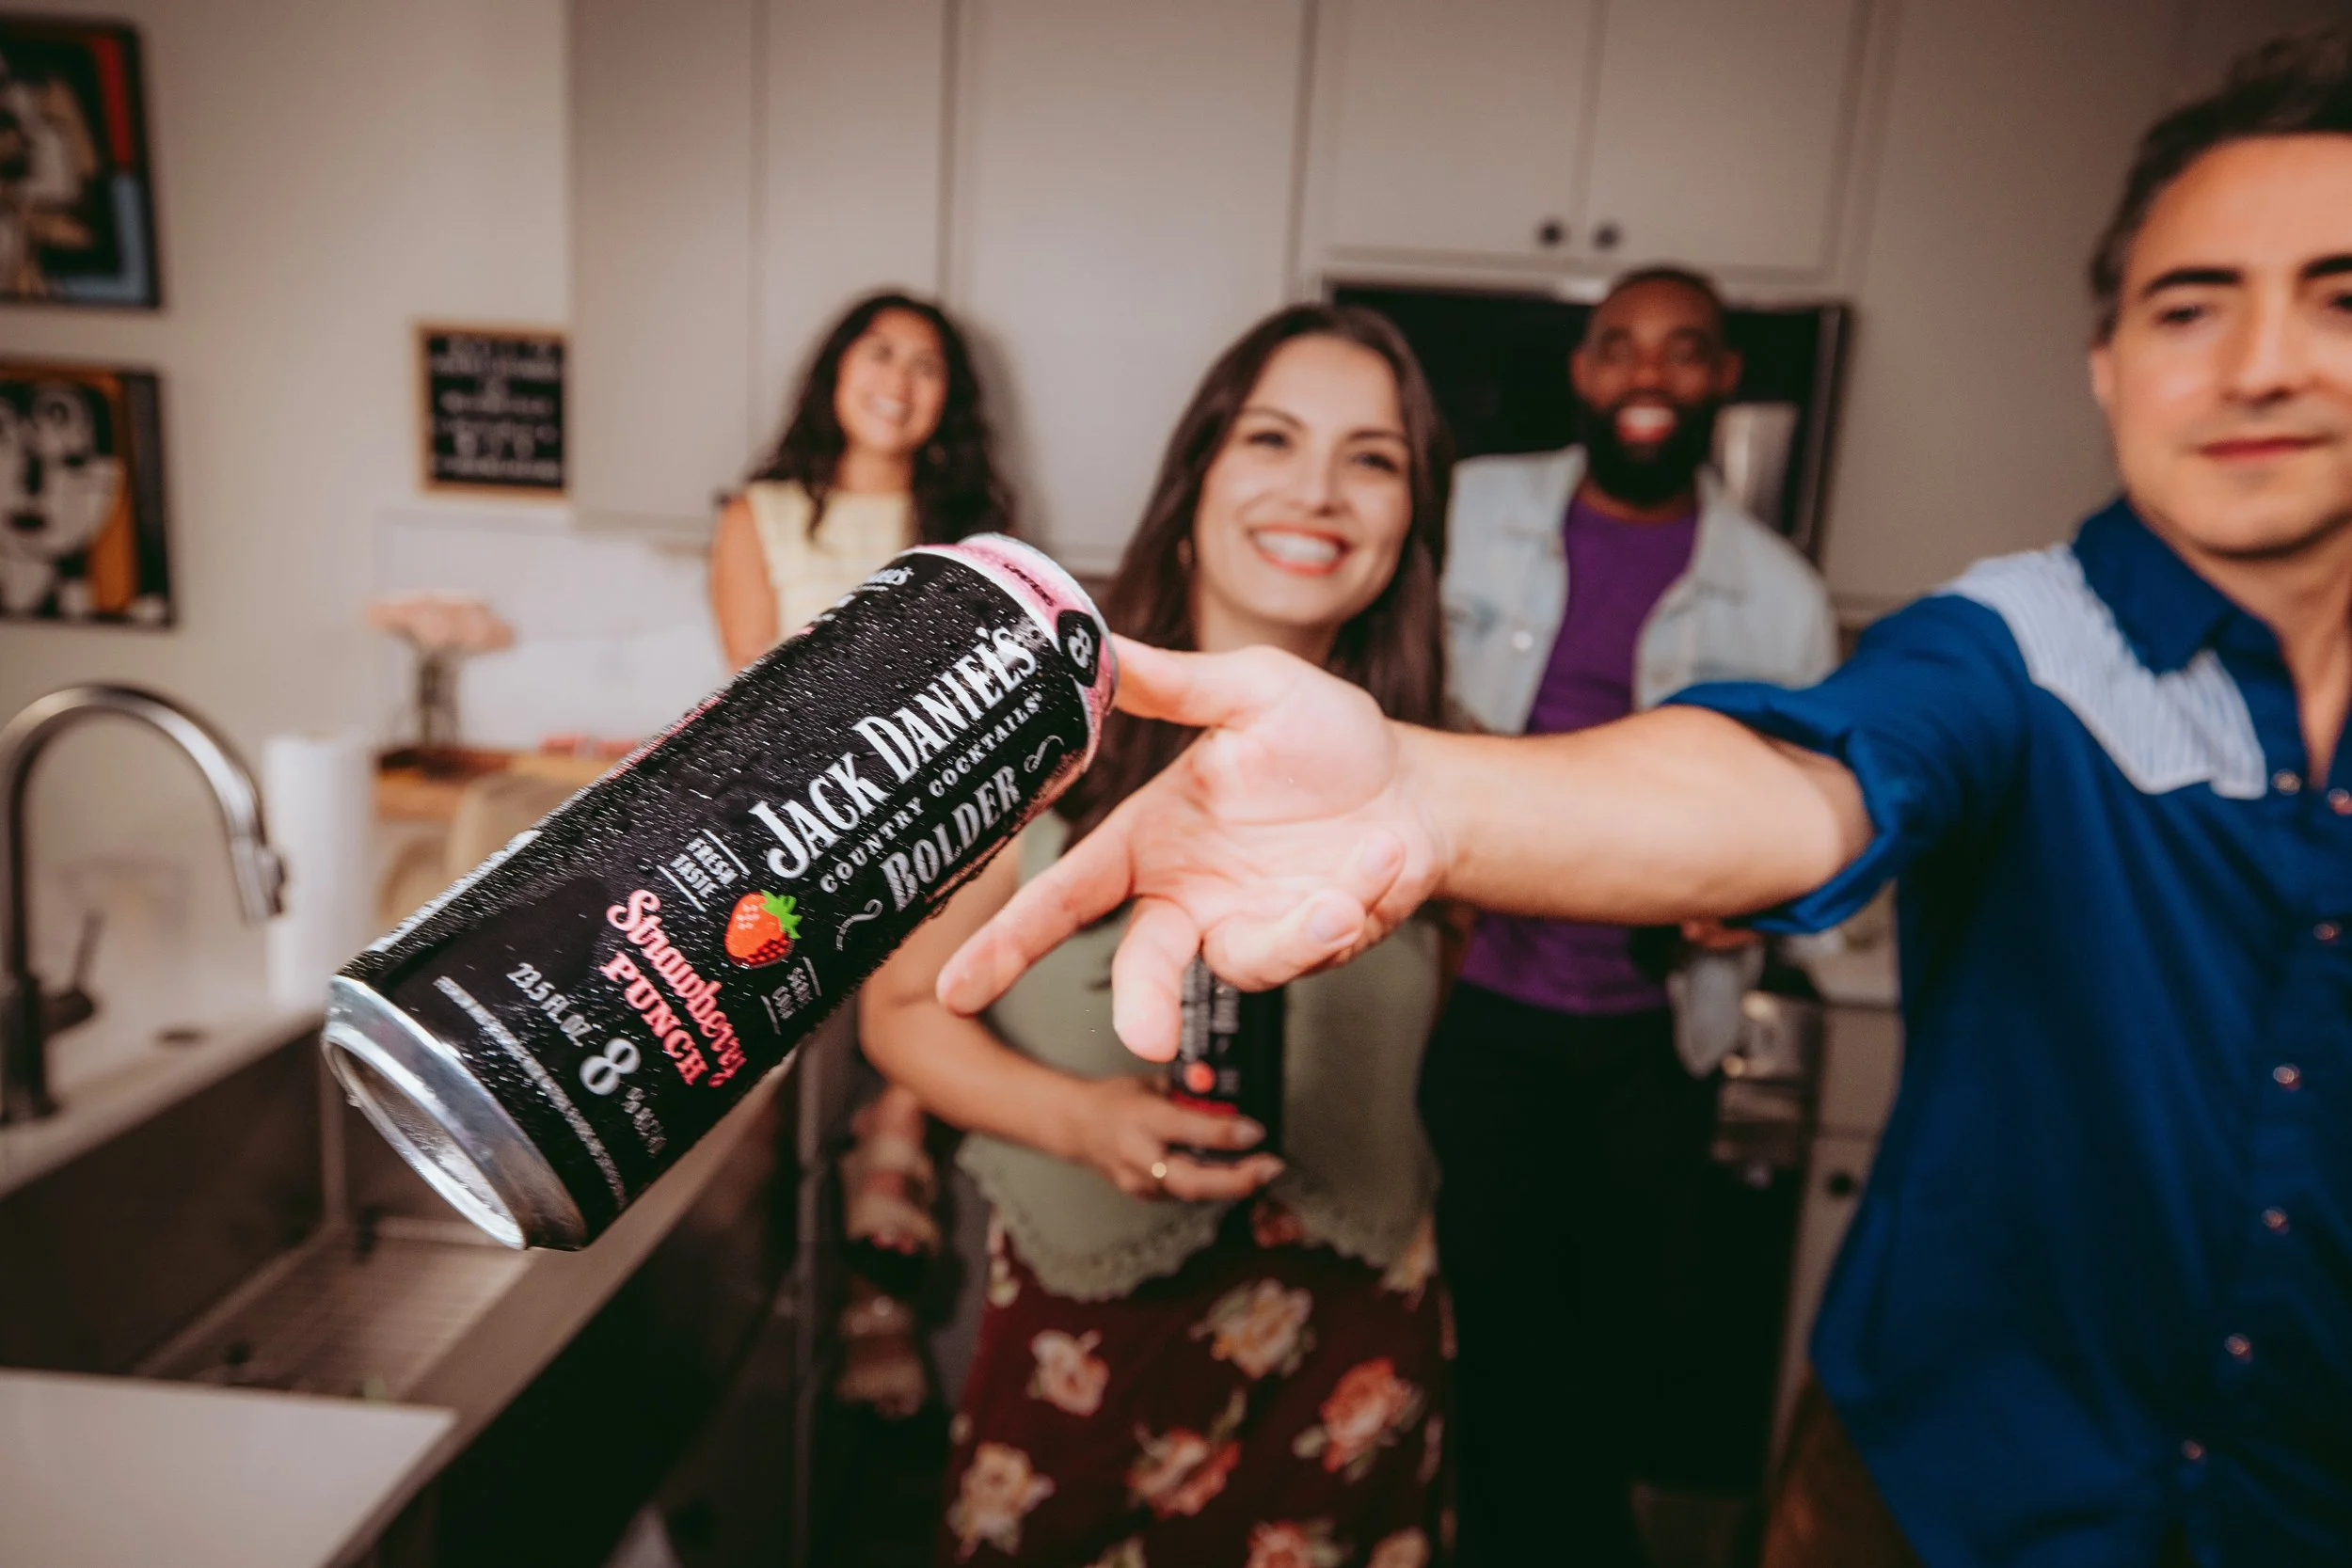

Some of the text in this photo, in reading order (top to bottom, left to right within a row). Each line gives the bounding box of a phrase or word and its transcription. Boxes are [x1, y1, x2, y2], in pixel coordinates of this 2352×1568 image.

[748, 626, 1036, 879] JACK DANIEL'S
[670, 853, 719, 898] TASTE
[685, 838, 739, 884] FRESH
[819, 797, 926, 893] COUNTRY
[879, 766, 1022, 912] BOLDER
[598, 951, 708, 1085] PUNCH
[606, 889, 747, 1087] Strawberry
